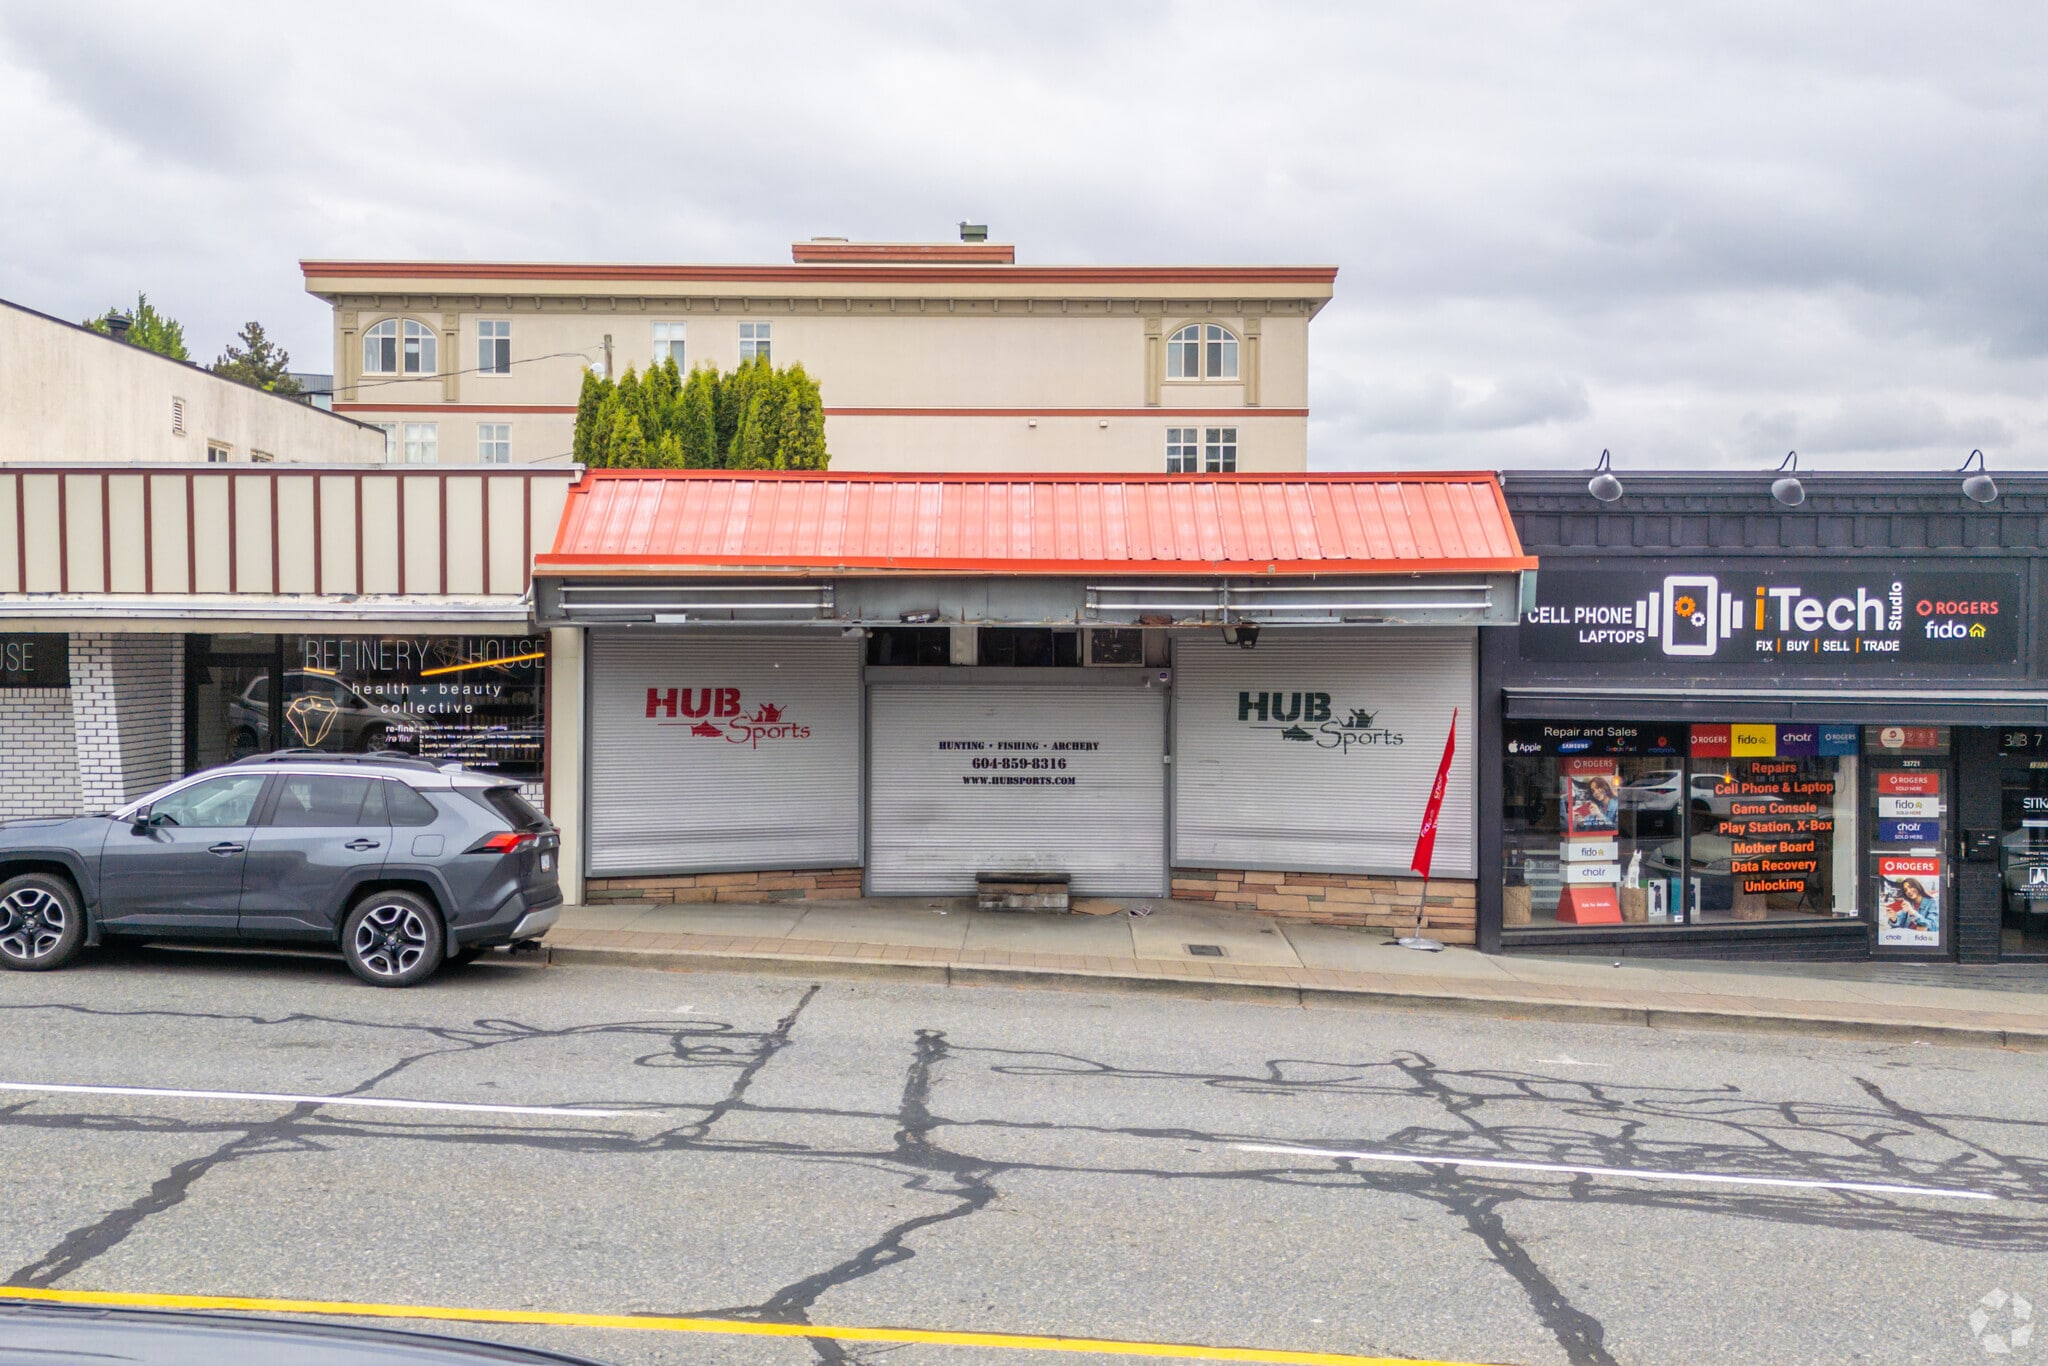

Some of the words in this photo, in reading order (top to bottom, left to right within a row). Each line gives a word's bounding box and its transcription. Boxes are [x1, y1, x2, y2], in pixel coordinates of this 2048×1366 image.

[1888, 582, 1902, 631] Studio
[1935, 601, 1999, 615] ROGERS
[1528, 607, 1570, 624] CELL
[1575, 607, 1632, 624] PHONE
[1925, 620, 1967, 638] fido
[1579, 630, 1645, 643] LAPTOPS
[1756, 640, 1773, 651] FIX
[1787, 640, 1809, 651] BUY
[1823, 640, 1850, 651] SELL
[1863, 640, 1900, 651] TRADE
[305, 640, 430, 671] REFINERY
[469, 640, 546, 669] HOUSE
[352, 683, 410, 695] health
[439, 683, 502, 698] beauty
[380, 702, 474, 714] collective
[645, 688, 741, 718] HUB
[1238, 692, 1332, 722] HUB
[726, 716, 810, 749] Sports
[1316, 721, 1404, 755] Sports
[1544, 727, 1580, 738] Repair
[1583, 727, 1604, 737] and
[1607, 727, 1637, 737] Sales
[1782, 733, 1812, 742] chatr
[1698, 736, 1727, 744] ROGERS
[1737, 734, 1758, 744] fido
[939, 741, 985, 750] HUNTING
[998, 742, 1039, 750] FISHING
[1052, 742, 1099, 750] ARCHERY
[1519, 743, 1542, 753] Apple
[972, 757, 1067, 770] 604-859-8316
[1582, 759, 1613, 768] ROGERS
[1752, 762, 1797, 775] Repairs
[963, 776, 1076, 785] WWW.HUBSPORTS.COM
[1715, 784, 1738, 795] Cell
[1742, 782, 1779, 794] Phone
[1782, 782, 1791, 792] &
[1794, 780, 1834, 795] Laptop
[1732, 804, 1766, 814] Game
[1769, 802, 1817, 813] Console
[1895, 800, 1914, 809] fido
[2022, 797, 2048, 809] SITK
[1719, 822, 1745, 835] Play
[1749, 821, 1794, 833] Station,
[1797, 820, 1832, 831] X-Box
[1896, 823, 1921, 831] chatr
[1581, 847, 1598, 857] fido
[1734, 842, 1777, 854] Mother
[1780, 840, 1815, 852] Board
[1732, 861, 1759, 872] Data
[1762, 860, 1817, 872] Recovery
[1896, 862, 1934, 871] ROGERS
[1745, 879, 1804, 892] Unlocking
